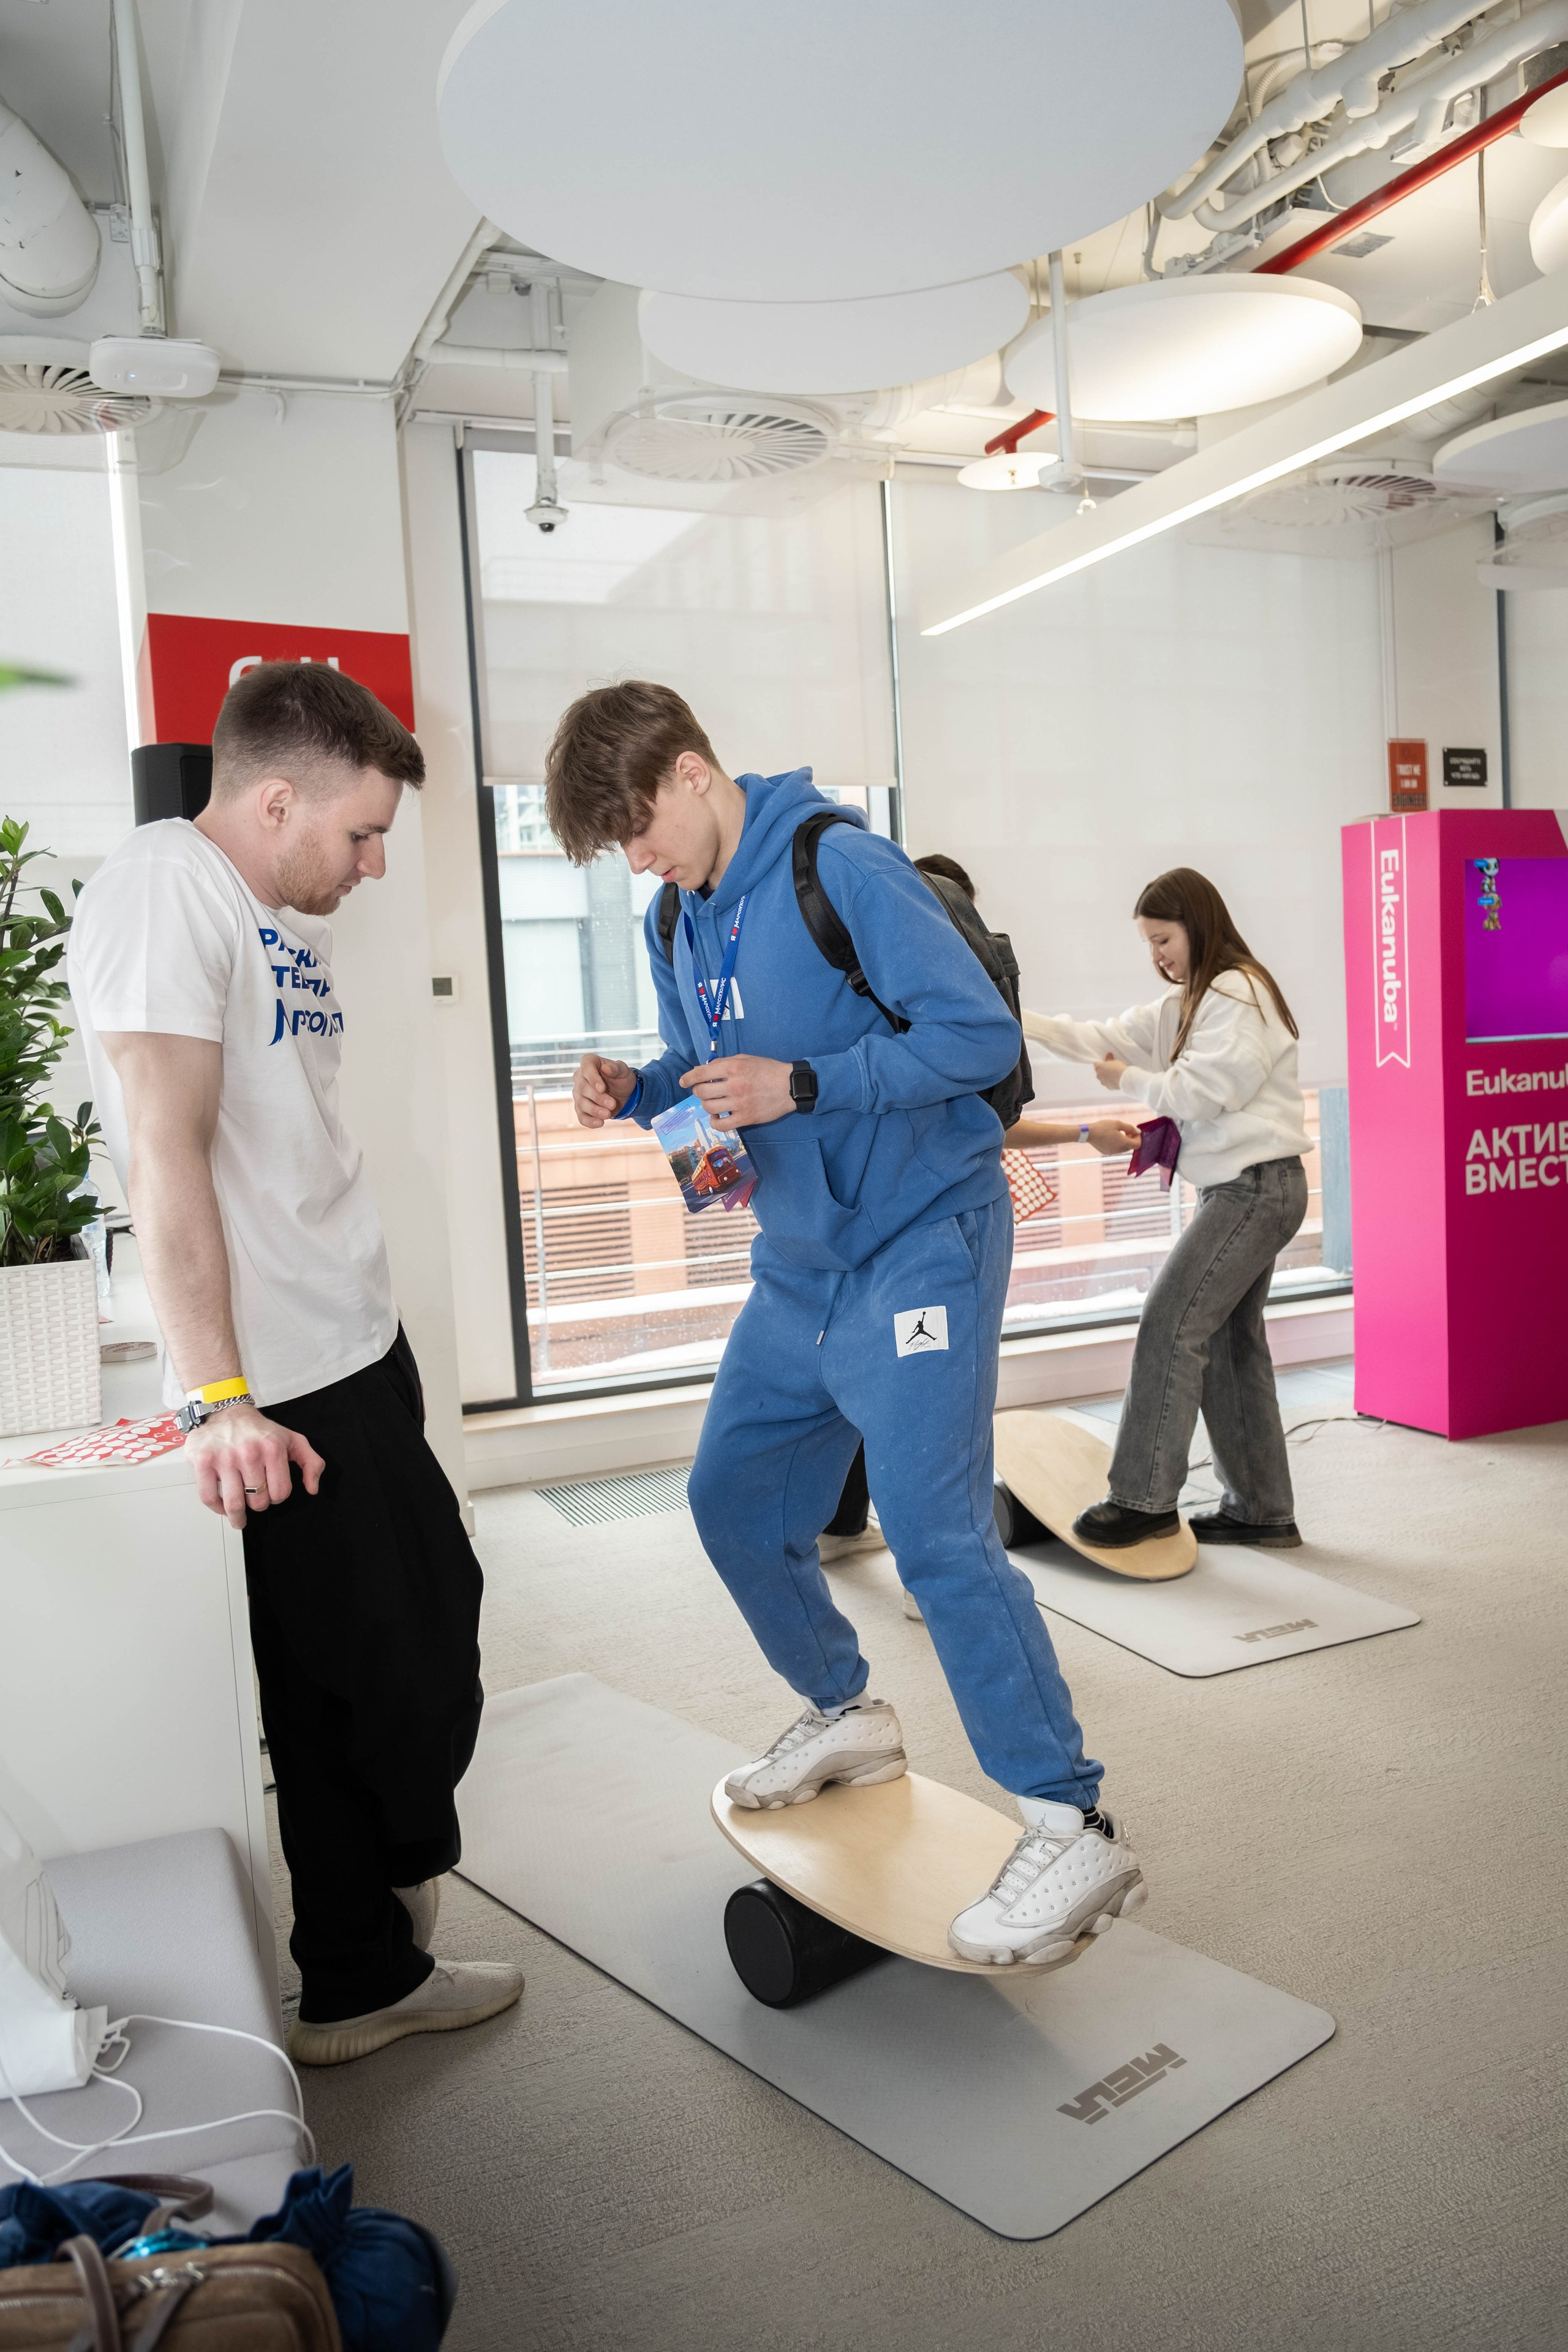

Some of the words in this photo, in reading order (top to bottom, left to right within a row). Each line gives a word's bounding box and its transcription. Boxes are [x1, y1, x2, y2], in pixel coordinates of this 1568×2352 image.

[1381, 849, 1401, 1023] Eukanuba
[1466, 1063, 1568, 1096] Eukanu
[908, 1338, 931, 1351] Flight
